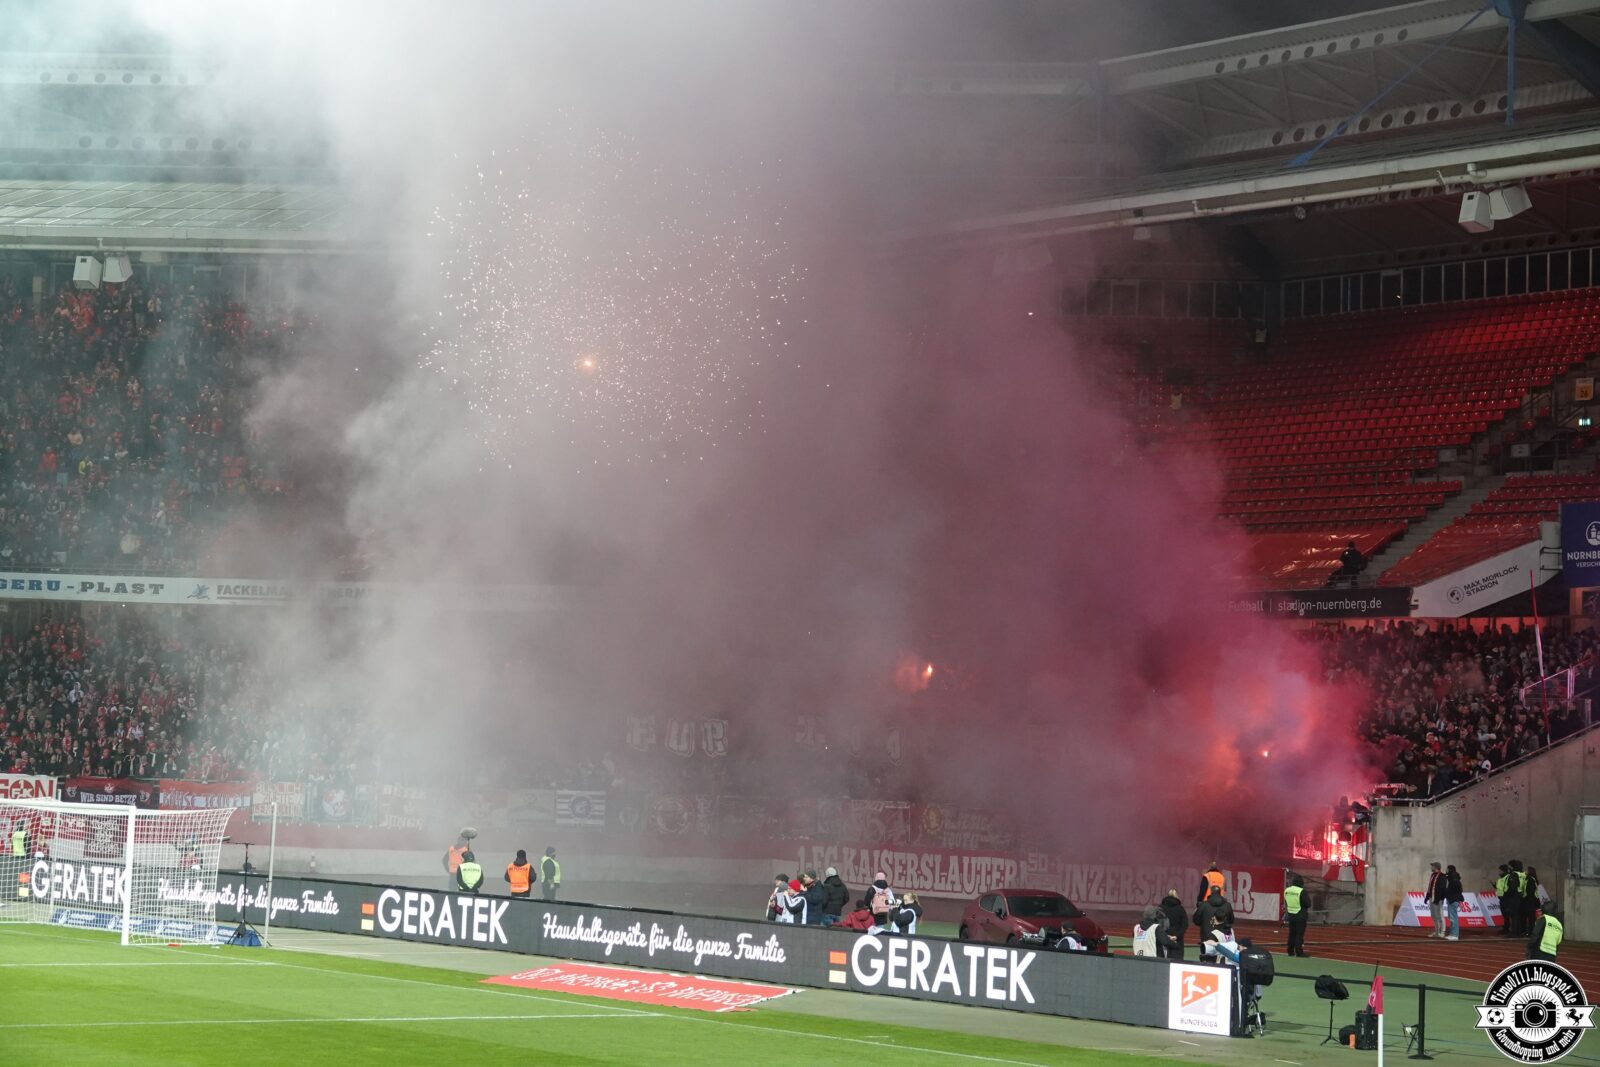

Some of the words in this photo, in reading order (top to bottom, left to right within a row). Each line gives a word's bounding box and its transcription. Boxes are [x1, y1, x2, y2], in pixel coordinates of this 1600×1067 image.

[80, 582, 164, 595] PLAST
[1464, 580, 1481, 591] MAX
[1482, 565, 1519, 582] MORLOCK
[1466, 580, 1499, 597] STADION
[1278, 598, 1382, 613] stadion-nuernberg.de
[80, 791, 95, 803] WIR
[96, 793, 114, 802] SIND
[115, 794, 136, 805] BETZE
[31, 860, 128, 905] GERATEK
[1058, 863, 1254, 913] UNZERSTÖRAR
[270, 890, 299, 920] ganze
[299, 890, 340, 915] Familie
[378, 888, 510, 944] GERATEK
[543, 912, 647, 956] Haushaltsgeräte
[649, 922, 671, 957] für
[671, 924, 694, 952] die
[695, 938, 732, 966] ganze
[733, 932, 787, 963] Familie
[851, 934, 1037, 1004] GERATEK
[1180, 1017, 1218, 1028] BUNDESLIGA
